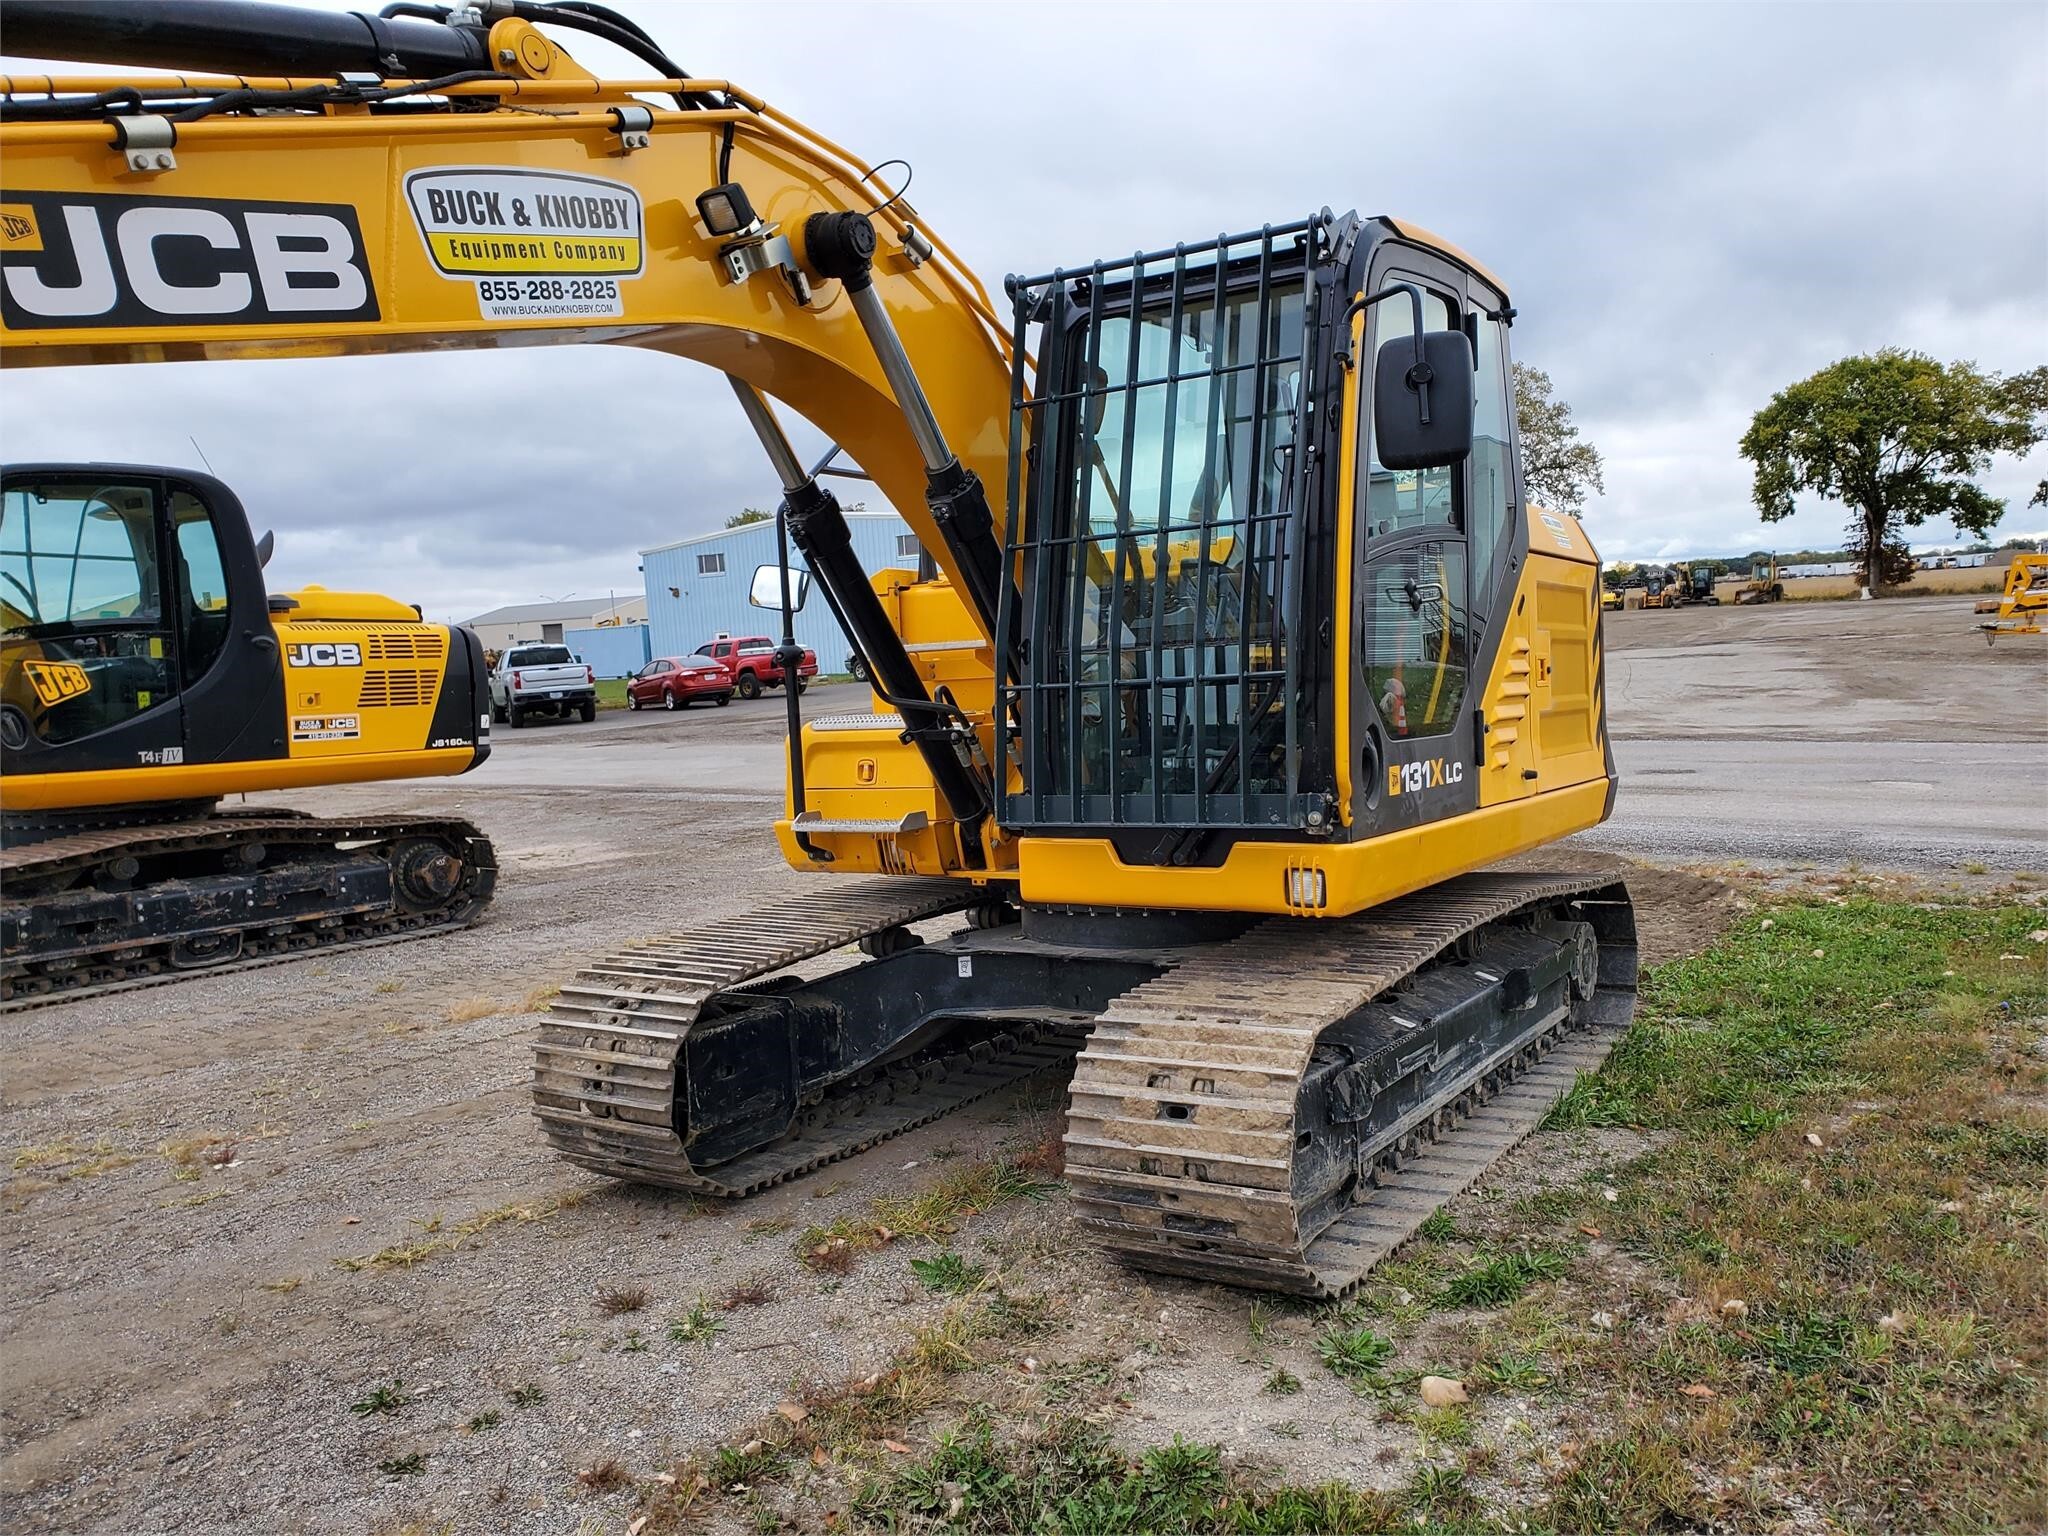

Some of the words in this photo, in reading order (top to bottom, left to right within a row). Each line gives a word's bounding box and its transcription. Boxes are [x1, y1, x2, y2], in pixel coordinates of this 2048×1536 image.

[427, 188, 506, 226] BUCK
[512, 198, 531, 227] &
[535, 194, 630, 230] KNOBBY
[1, 215, 32, 238] JCB
[3, 205, 367, 316] JCB
[449, 239, 547, 261] Equipment
[553, 241, 626, 262] Company
[480, 280, 617, 302] 855-288-2825
[492, 304, 614, 316] WWW.BUCKANDKNOBBY.COM
[289, 644, 361, 666] JCB
[36, 664, 86, 702] JCB
[327, 718, 356, 729] JCB
